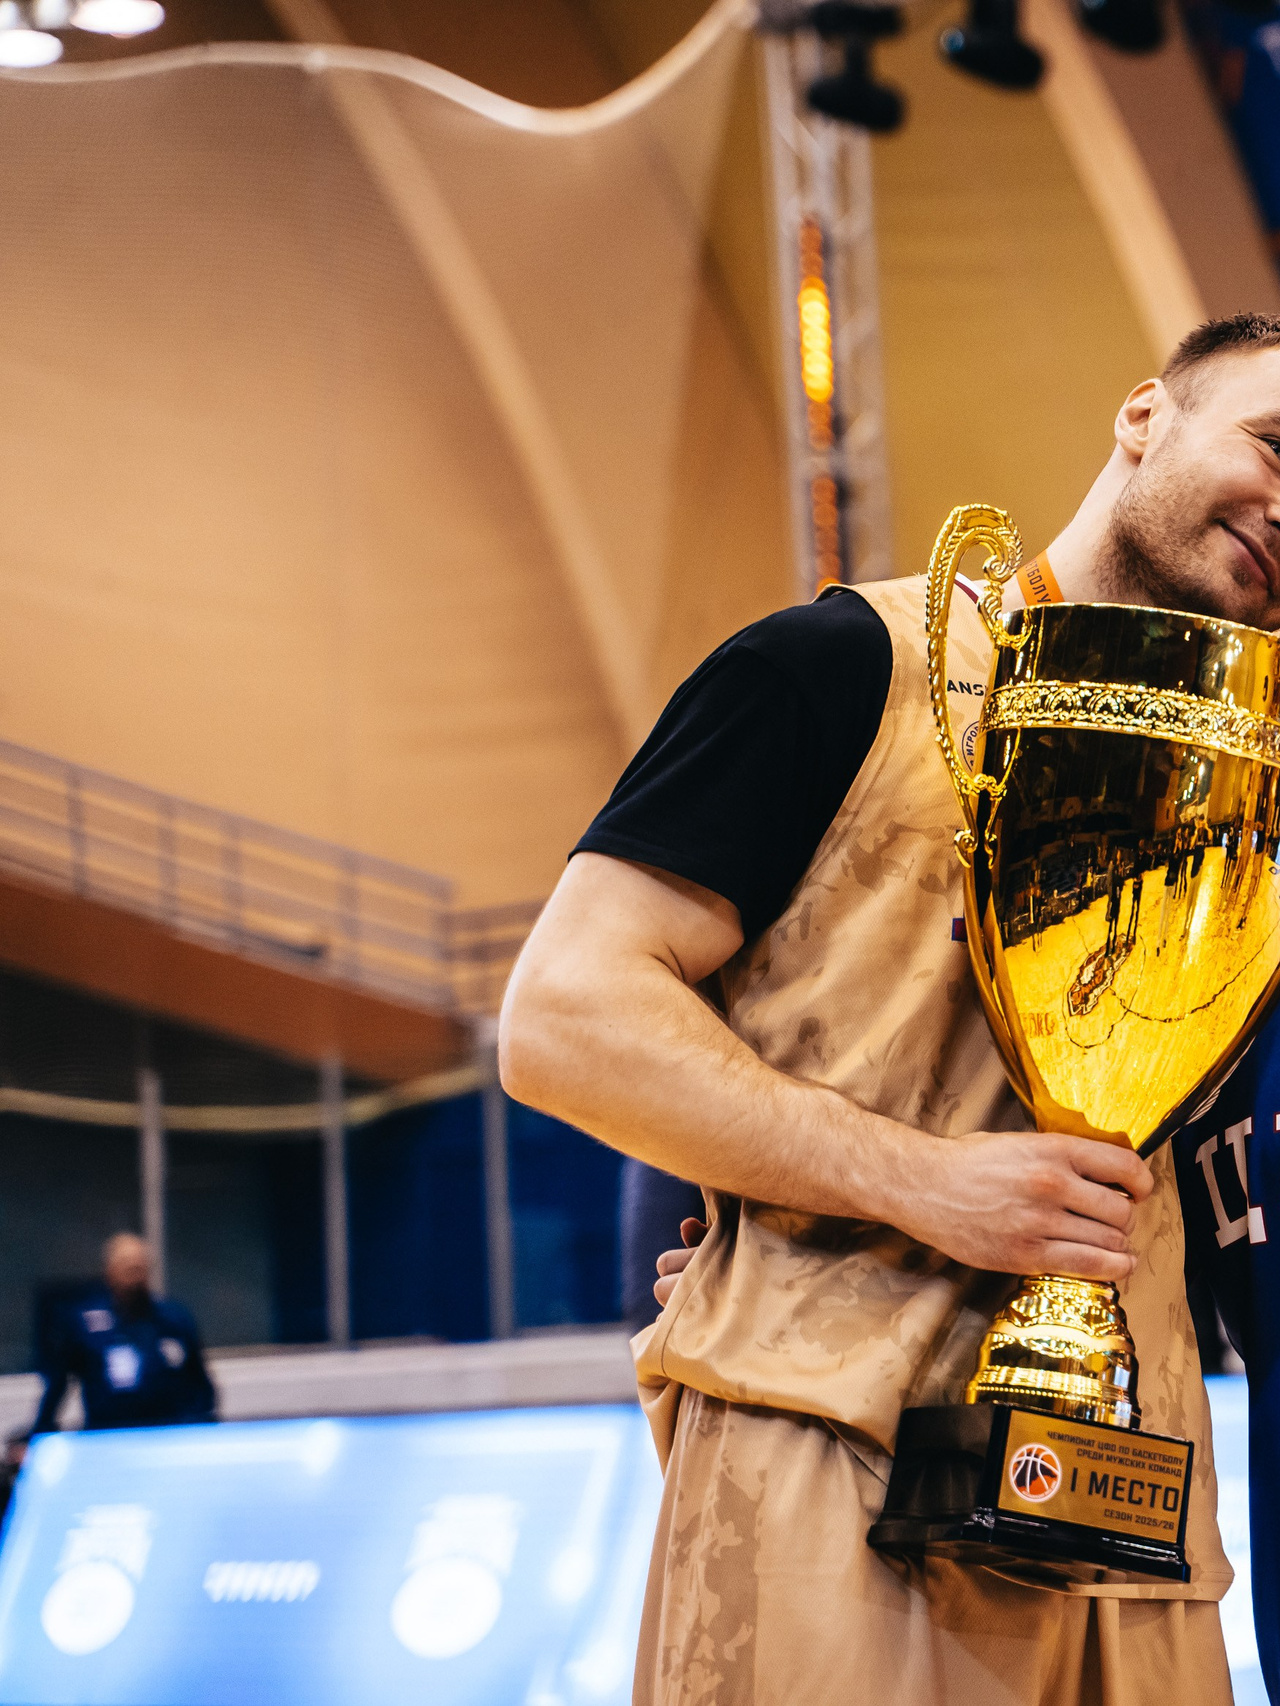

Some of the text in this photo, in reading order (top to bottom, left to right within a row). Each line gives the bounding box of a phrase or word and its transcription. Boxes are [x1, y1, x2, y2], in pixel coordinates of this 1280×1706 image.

[1047, 1430, 1184, 1466] ЧЕМПИОНАТ ЦФО ПО БАСКЕТБОЛУ
[1076, 1447, 1182, 1478] СРЕДИ МУЖСКИХ КОМАНД
[1088, 1470, 1180, 1513] МЕСТО
[1103, 1507, 1175, 1531] СЕЗОН 2025/26
